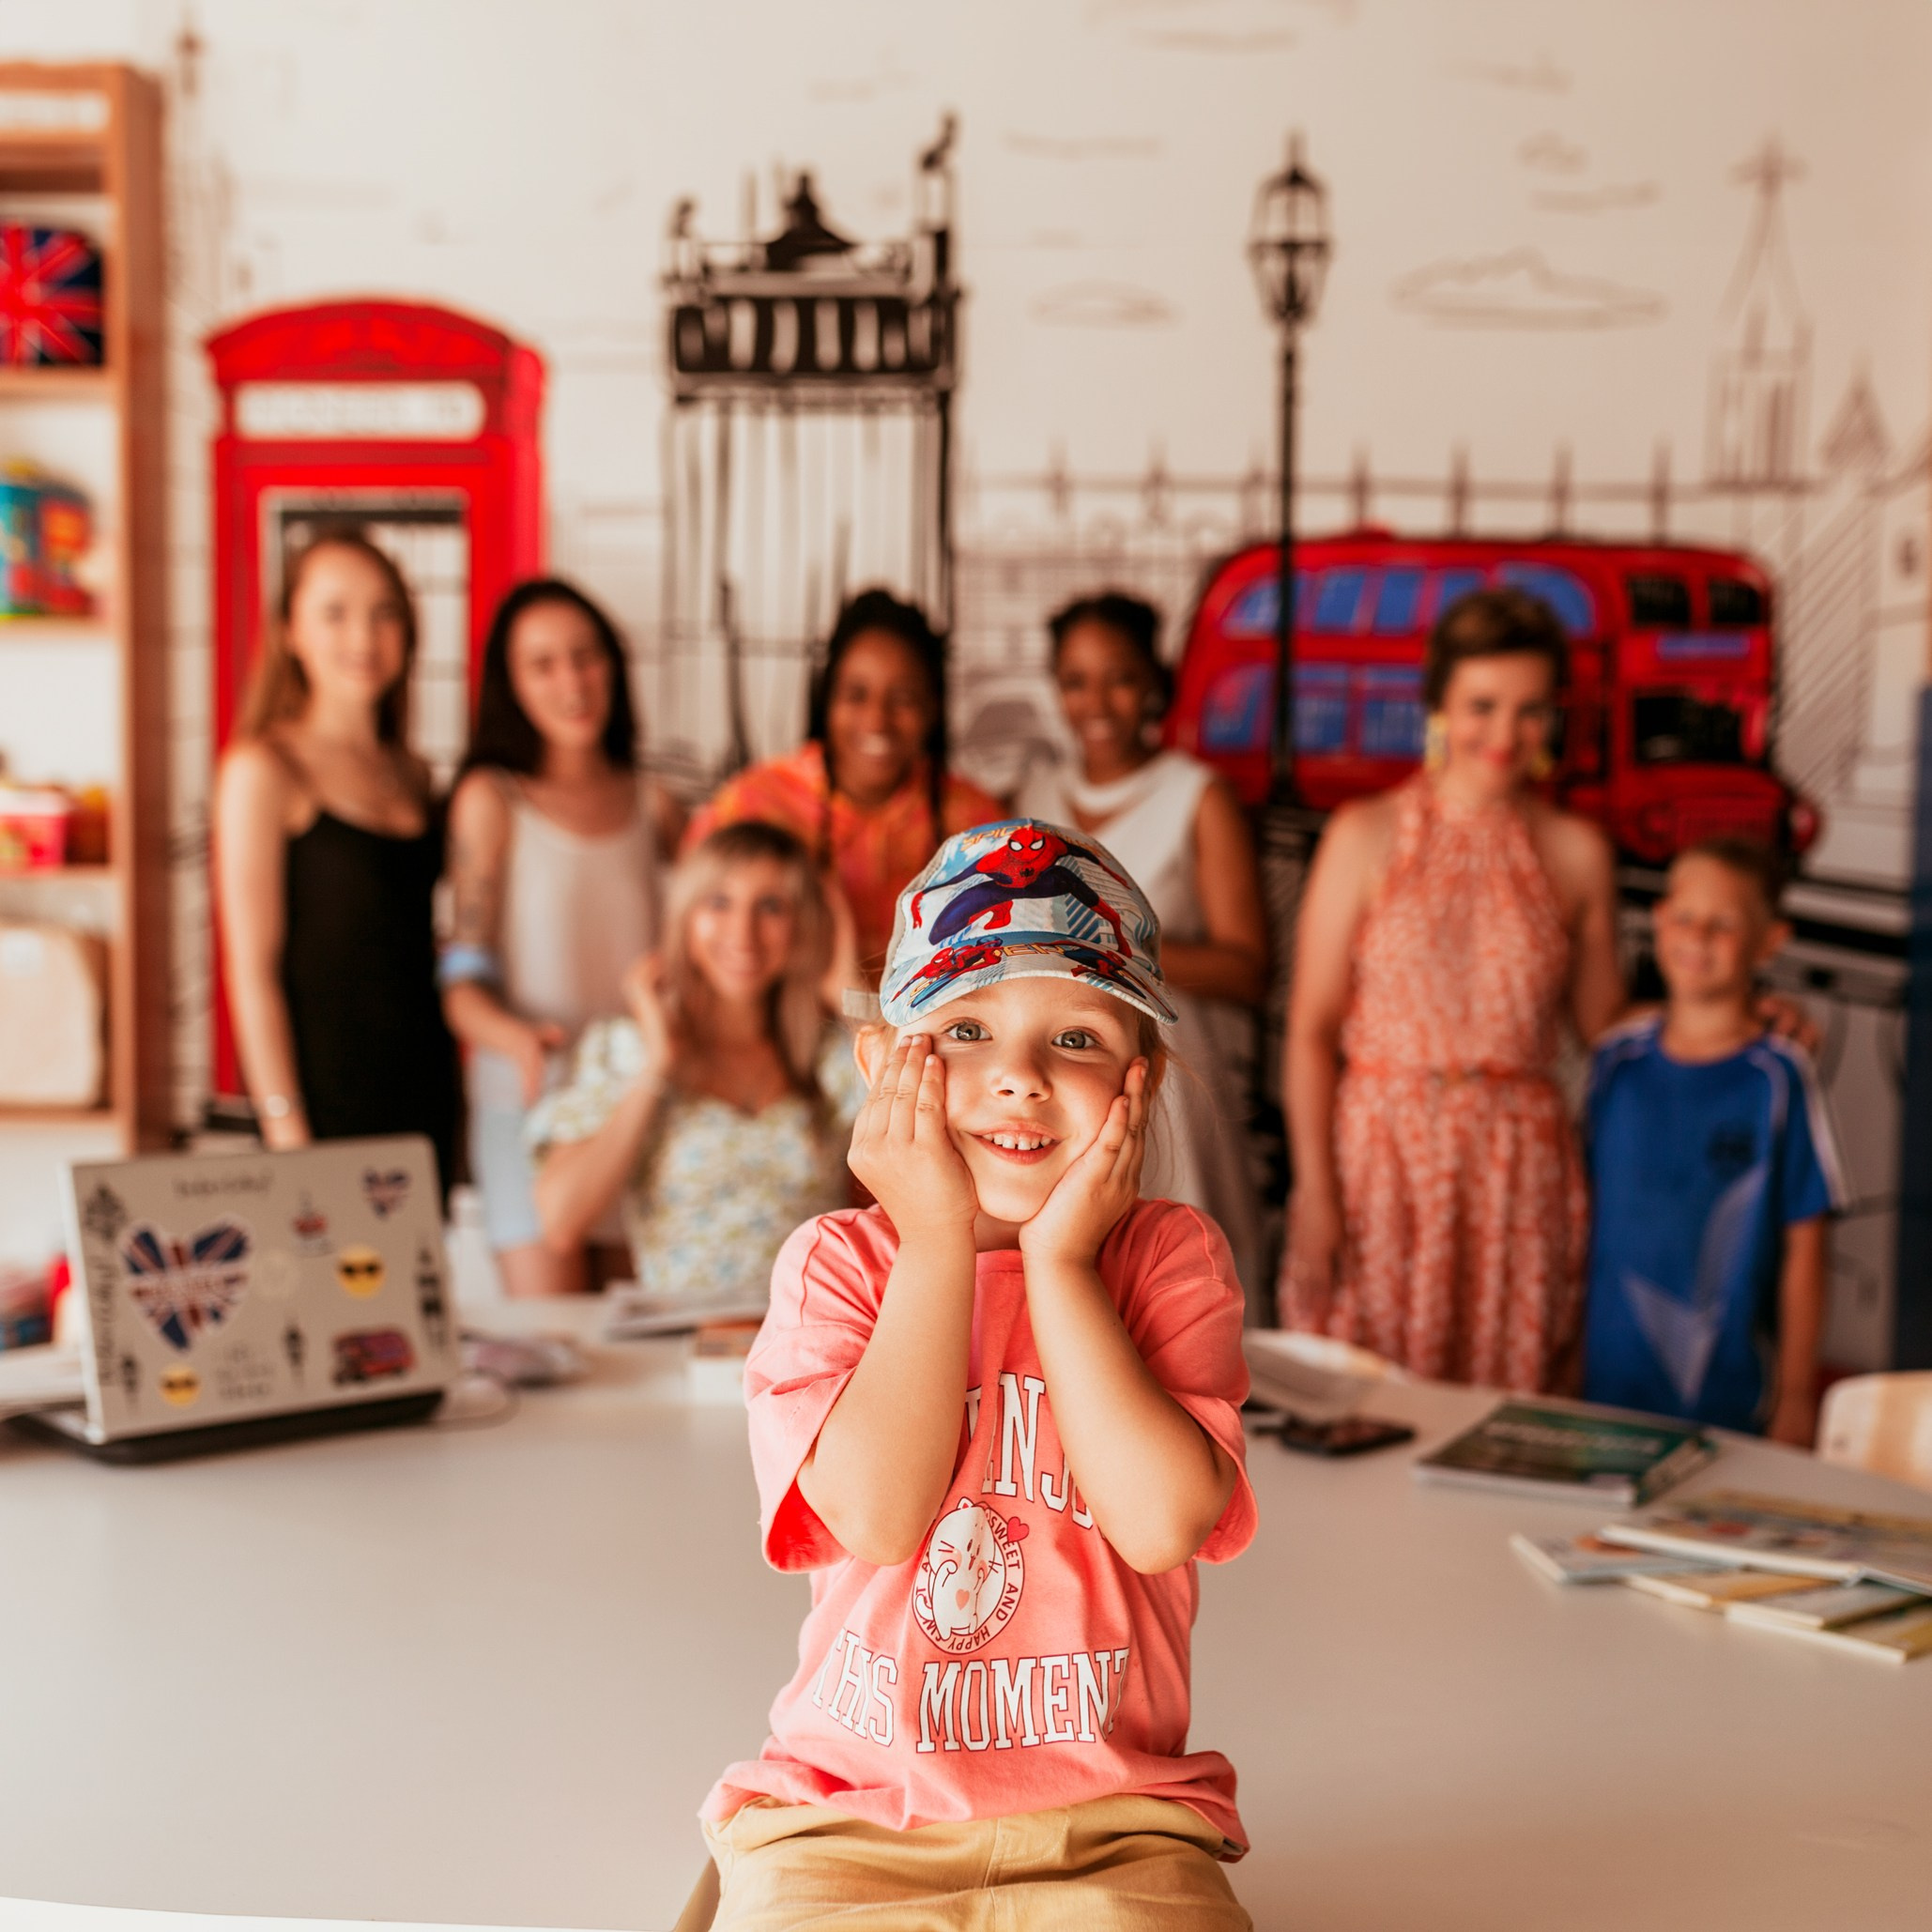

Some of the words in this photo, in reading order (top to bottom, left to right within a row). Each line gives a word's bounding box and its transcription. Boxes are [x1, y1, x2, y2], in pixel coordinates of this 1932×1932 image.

[989, 1515, 1021, 1570] SWEET
[996, 1582, 1020, 1621] AND
[948, 1625, 991, 1651] HAPPY
